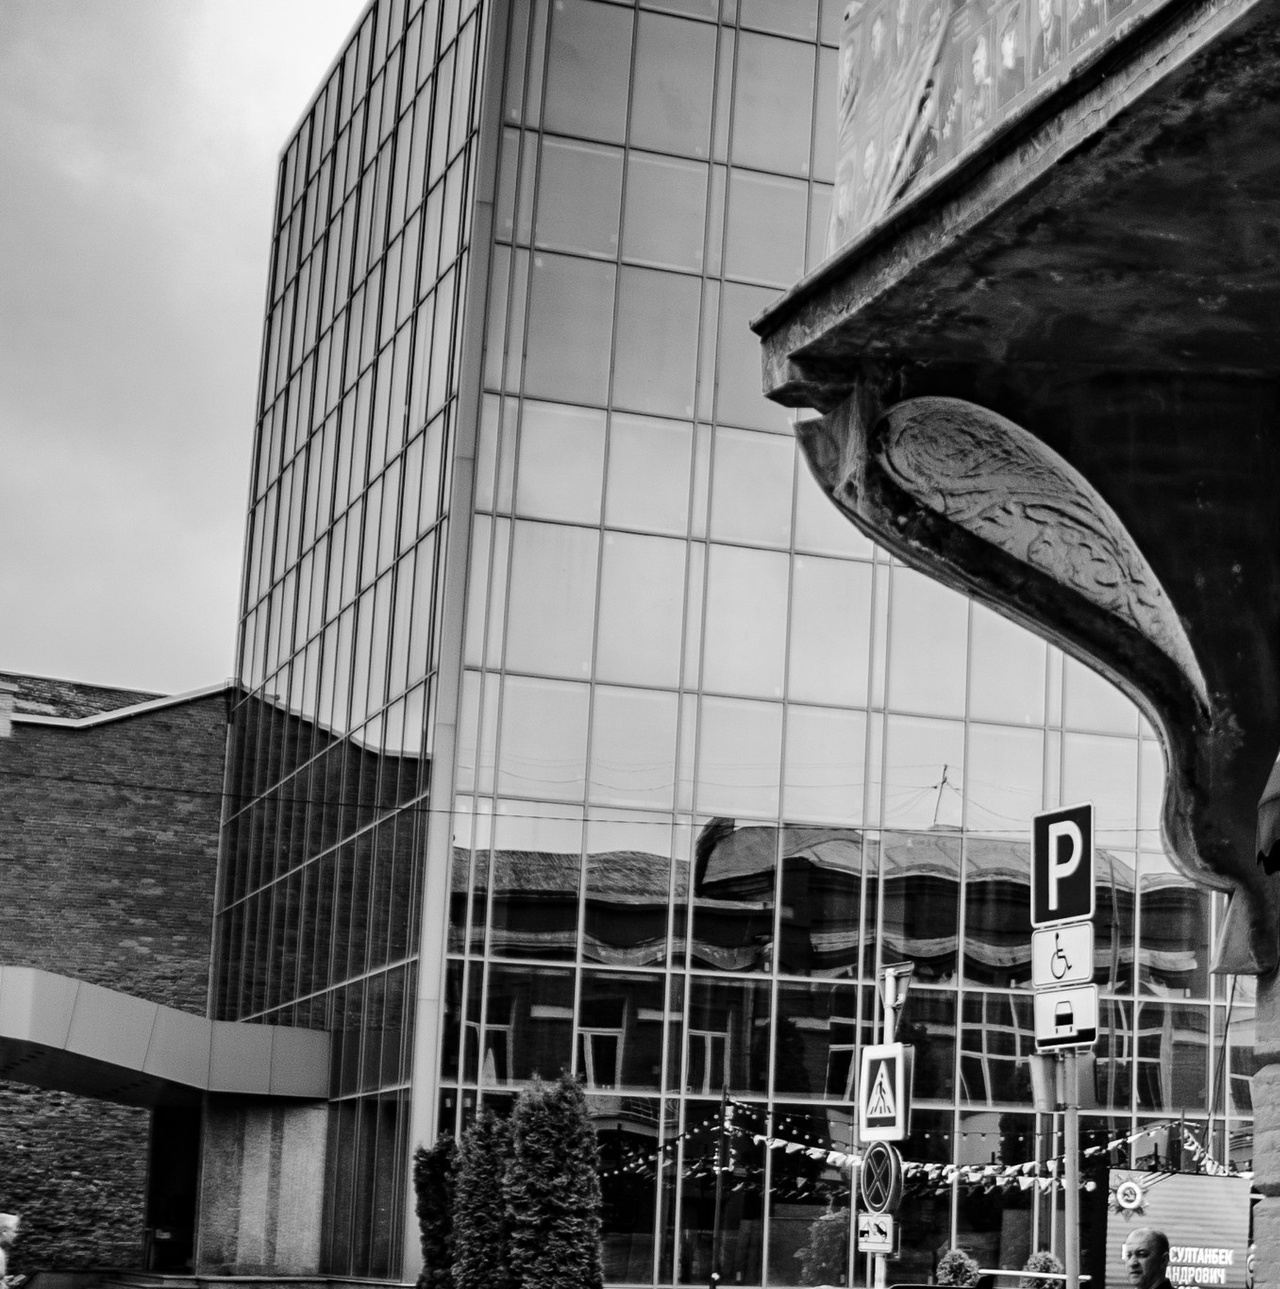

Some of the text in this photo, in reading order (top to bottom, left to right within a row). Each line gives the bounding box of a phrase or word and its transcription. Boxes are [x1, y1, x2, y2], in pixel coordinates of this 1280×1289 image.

[1048, 820, 1082, 911] P
[1168, 1246, 1234, 1265] СУЛТАНБЕК
[1165, 1266, 1226, 1285] АНДРОВИЧ
